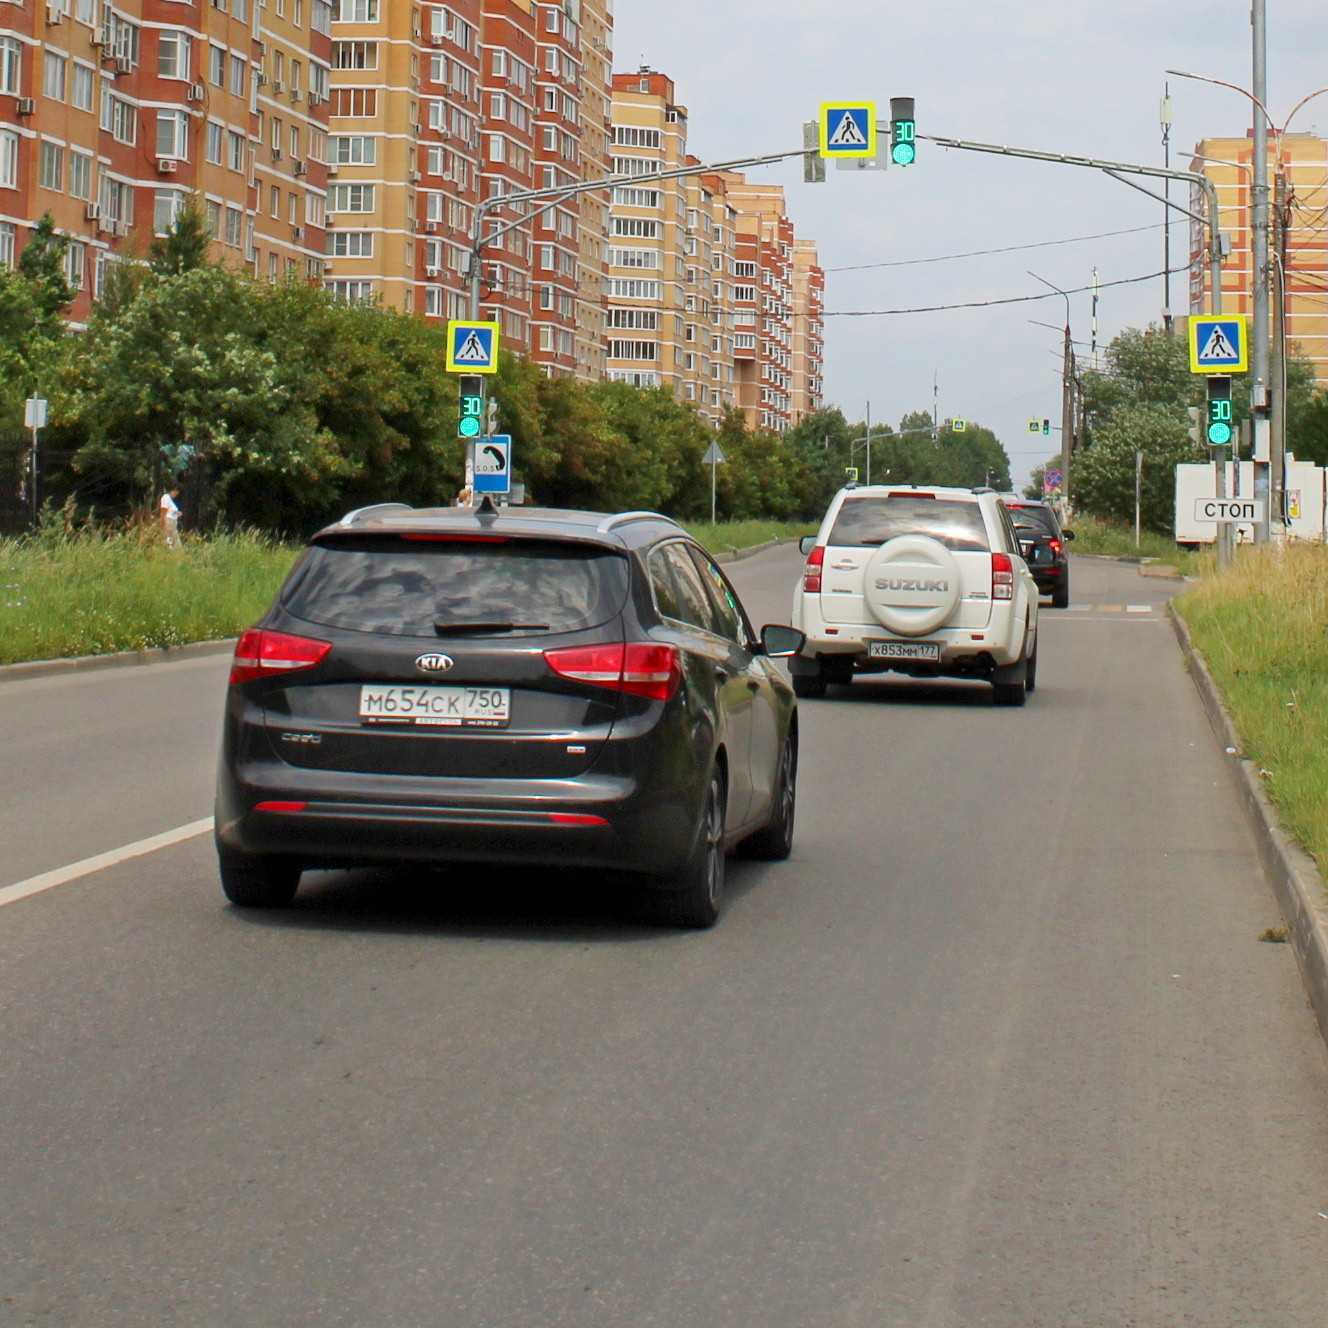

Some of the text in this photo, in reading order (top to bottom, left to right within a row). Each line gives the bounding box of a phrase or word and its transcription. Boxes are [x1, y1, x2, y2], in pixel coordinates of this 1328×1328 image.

[895, 122, 914, 141] 30
[463, 397, 481, 415] 30
[1212, 400, 1231, 420] 30
[1204, 502, 1255, 518] СТОП
[875, 578, 949, 592] SUZUKI
[421, 657, 447, 669] KIA
[467, 690, 502, 708] 750
